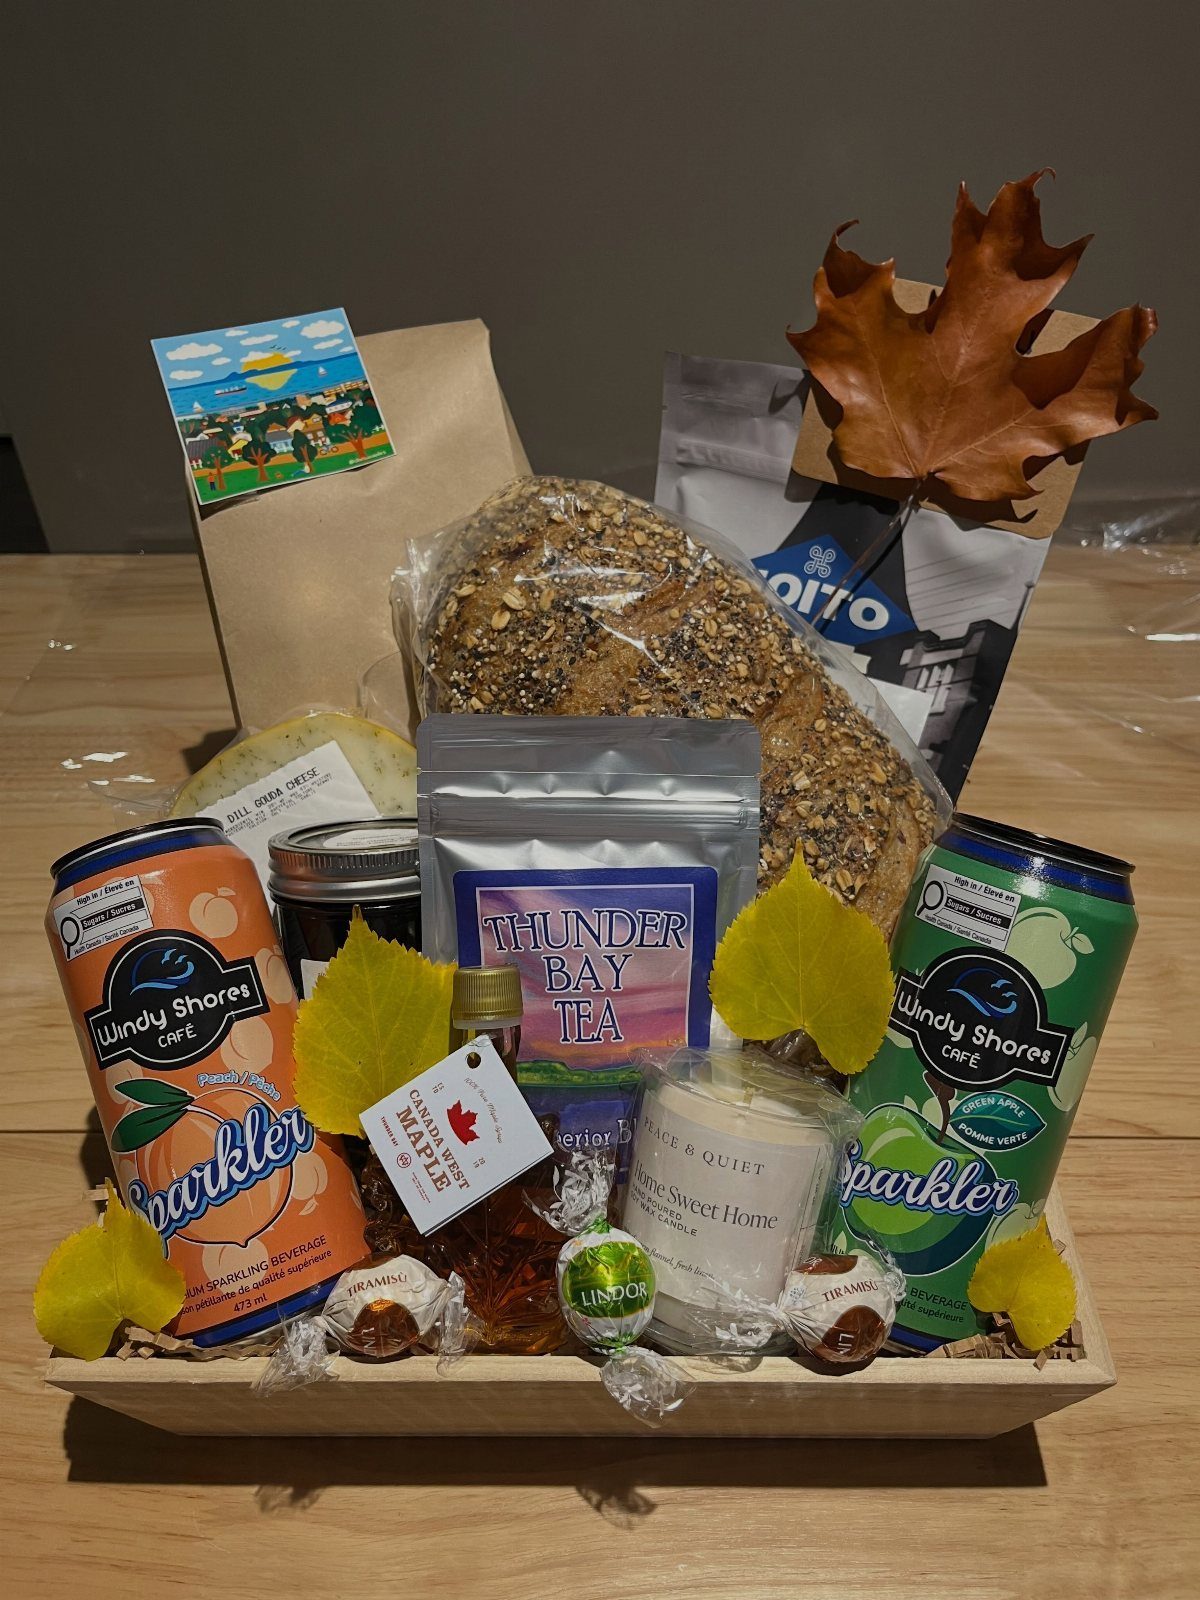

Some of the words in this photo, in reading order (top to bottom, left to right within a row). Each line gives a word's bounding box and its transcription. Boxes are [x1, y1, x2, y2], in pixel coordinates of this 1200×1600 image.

[759, 569, 889, 630] OITO
[227, 806, 252, 823] DILL
[254, 788, 284, 808] GOUDA
[285, 766, 320, 791] CHEESE
[77, 896, 91, 906] High
[91, 892, 98, 900] in
[105, 882, 124, 894] Élevé
[125, 879, 134, 887] en
[954, 876, 969, 887] High
[970, 882, 977, 890] in
[983, 886, 1004, 899] Élevé
[82, 914, 105, 928] Sugars
[110, 903, 136, 917] Sucres
[947, 898, 970, 914] Sugars
[975, 910, 1002, 924] Sucres
[85, 940, 101, 950] Canada
[119, 925, 139, 936] Canada
[483, 908, 688, 951] THUNDER
[936, 918, 953, 931] Canada
[971, 932, 992, 944] Canada
[542, 953, 633, 993] BAY
[97, 1008, 168, 1047] Windy
[172, 983, 251, 1018] Shores
[554, 998, 625, 1045] TEA
[897, 991, 965, 1042] Windy
[971, 1024, 1051, 1065] Shores
[158, 1022, 198, 1048] CAFÉ
[941, 1044, 981, 1069] CAFÉ
[197, 1070, 239, 1087] Peach
[239, 1071, 249, 1085] /
[248, 1073, 281, 1101] Pêche
[962, 1097, 995, 1114] GREEN
[997, 1098, 1026, 1118] APPLE
[409, 1089, 445, 1148] CANADA
[442, 1146, 470, 1190] WEST
[644, 1116, 679, 1149] PEACE
[684, 1143, 695, 1156] &
[702, 1150, 765, 1175] QUIET
[958, 1122, 995, 1145] POMME
[997, 1131, 1028, 1145] VERTE
[396, 1105, 452, 1192] MAPLE
[127, 1103, 316, 1258] Sparkler
[841, 1138, 1018, 1215] Sparkler
[634, 1160, 666, 1198] Home
[668, 1186, 718, 1220] Sweet
[722, 1204, 778, 1230] Home
[647, 1196, 682, 1221] POURED
[640, 1201, 656, 1217] WAX
[657, 1213, 698, 1237] CANDLE
[206, 1261, 269, 1292] SPARKLING
[271, 1235, 327, 1267] BEVERAGE
[673, 1260, 693, 1273] fresh
[196, 1290, 236, 1313] pétillante
[238, 1285, 250, 1295] de
[252, 1268, 286, 1290] qualité
[287, 1250, 332, 1274] supérieure
[346, 1271, 407, 1298] TIRAMISÙ
[581, 1282, 647, 1307] LINDOR
[822, 1278, 879, 1302] TIRAMISÙ
[233, 1299, 252, 1313] 473
[254, 1293, 268, 1305] ml
[910, 1287, 968, 1311] BEVERAGE
[917, 1306, 964, 1323] supérieure
